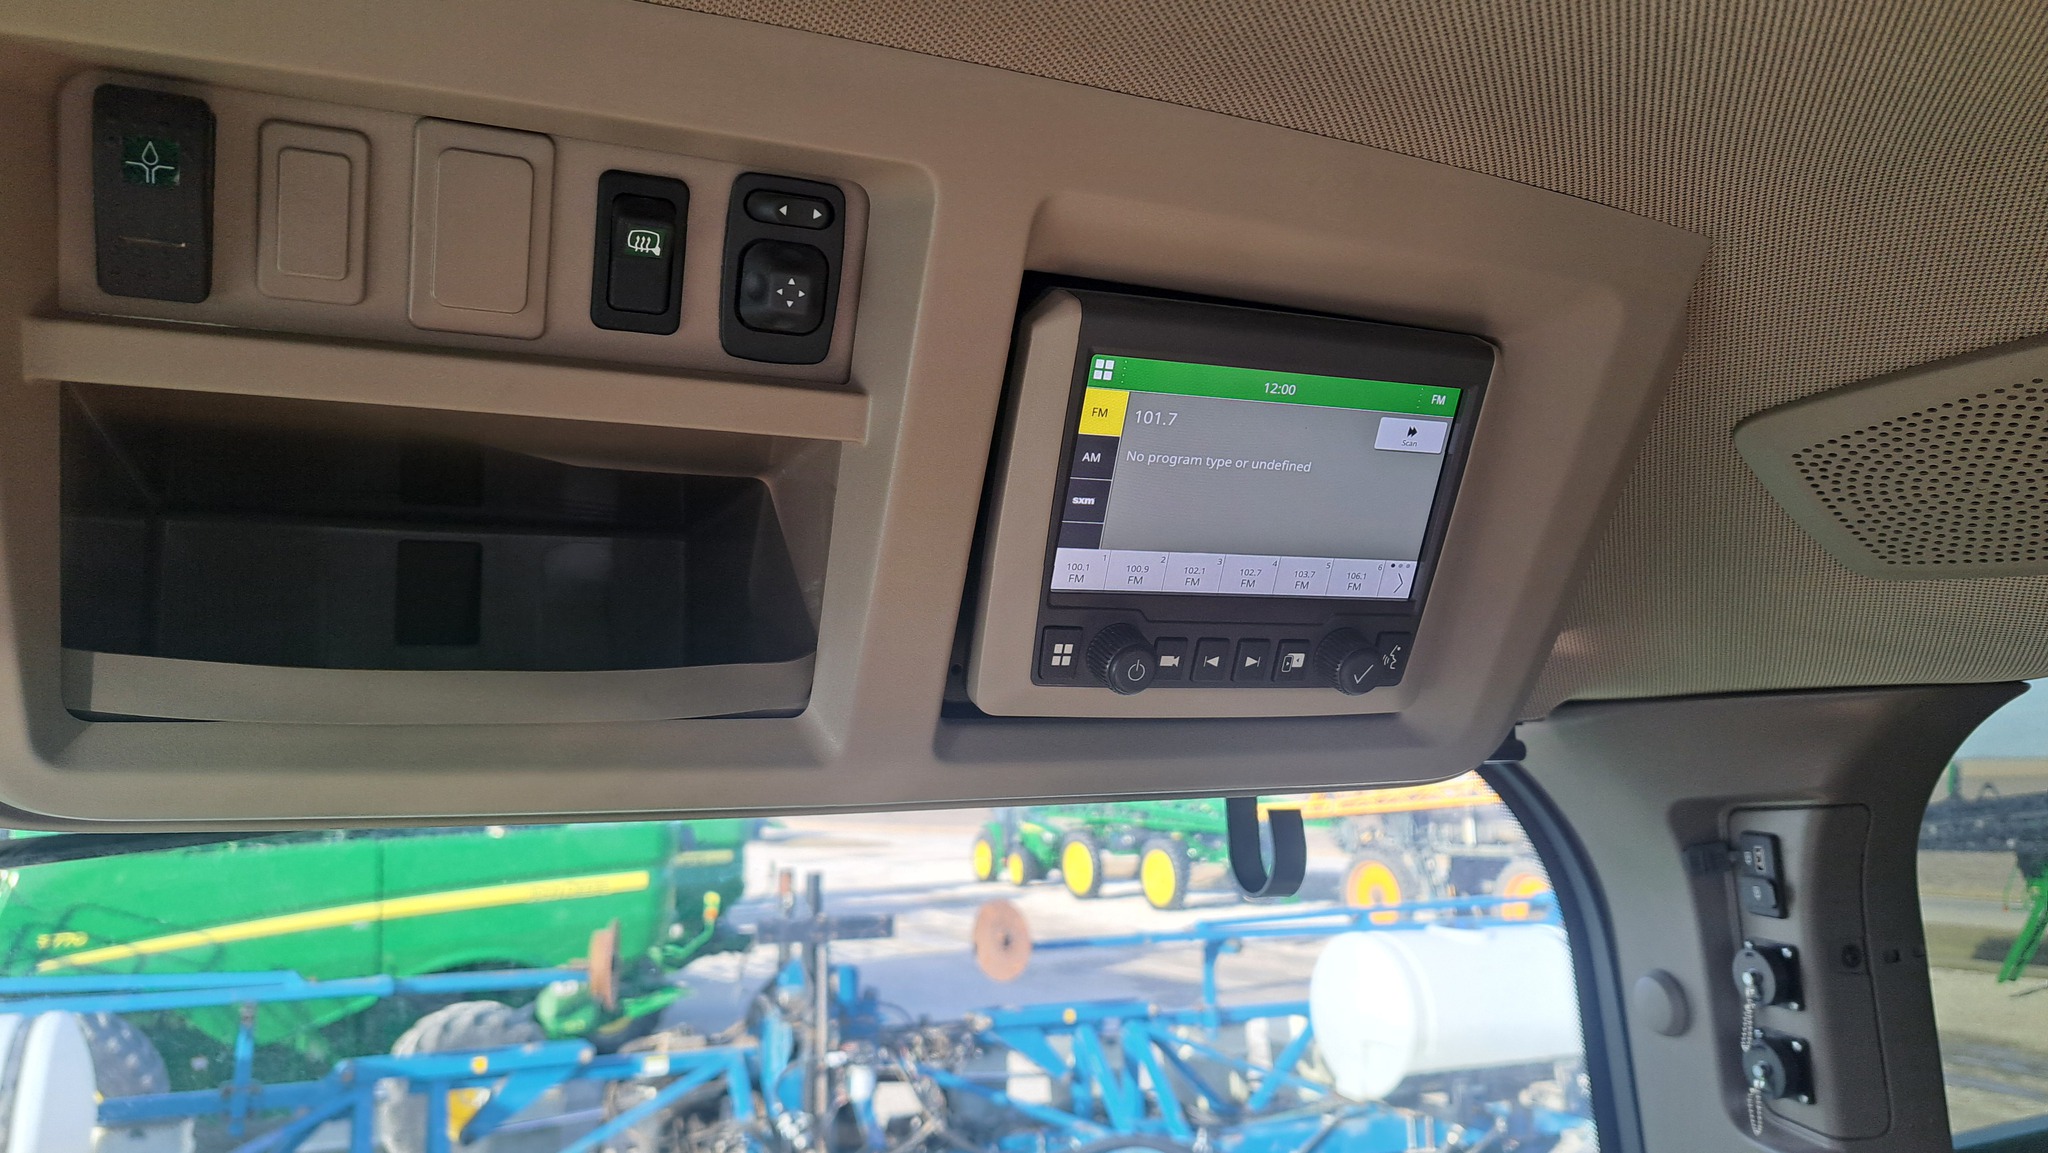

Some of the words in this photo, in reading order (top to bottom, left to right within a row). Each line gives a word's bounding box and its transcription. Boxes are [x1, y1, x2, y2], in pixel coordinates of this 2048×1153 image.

[1263, 382, 1296, 396] 12:00
[1431, 394, 1446, 405] FM
[1091, 406, 1109, 418] FM
[1135, 410, 1178, 426] 101.7
[1401, 439, 1418, 448] Scan
[1081, 451, 1101, 463] AM
[1125, 450, 1145, 462] No
[1147, 452, 1203, 467] program
[1205, 455, 1233, 470] type
[1235, 459, 1250, 469] or
[1251, 459, 1312, 473] undefined
[1072, 496, 1095, 505] sxm
[1067, 563, 1090, 571] 100.1
[1126, 565, 1150, 573] 100.9
[1183, 566, 1206, 575] 102.1
[1239, 568, 1262, 576] 102.7
[1293, 570, 1316, 578] 103.7
[1346, 572, 1367, 580] 106.1
[1068, 574, 1085, 583] FM
[1127, 575, 1144, 585] FM
[1184, 577, 1201, 586] FM
[1240, 579, 1256, 588] FM
[1294, 581, 1310, 590] FM
[1346, 582, 1362, 591] FM
